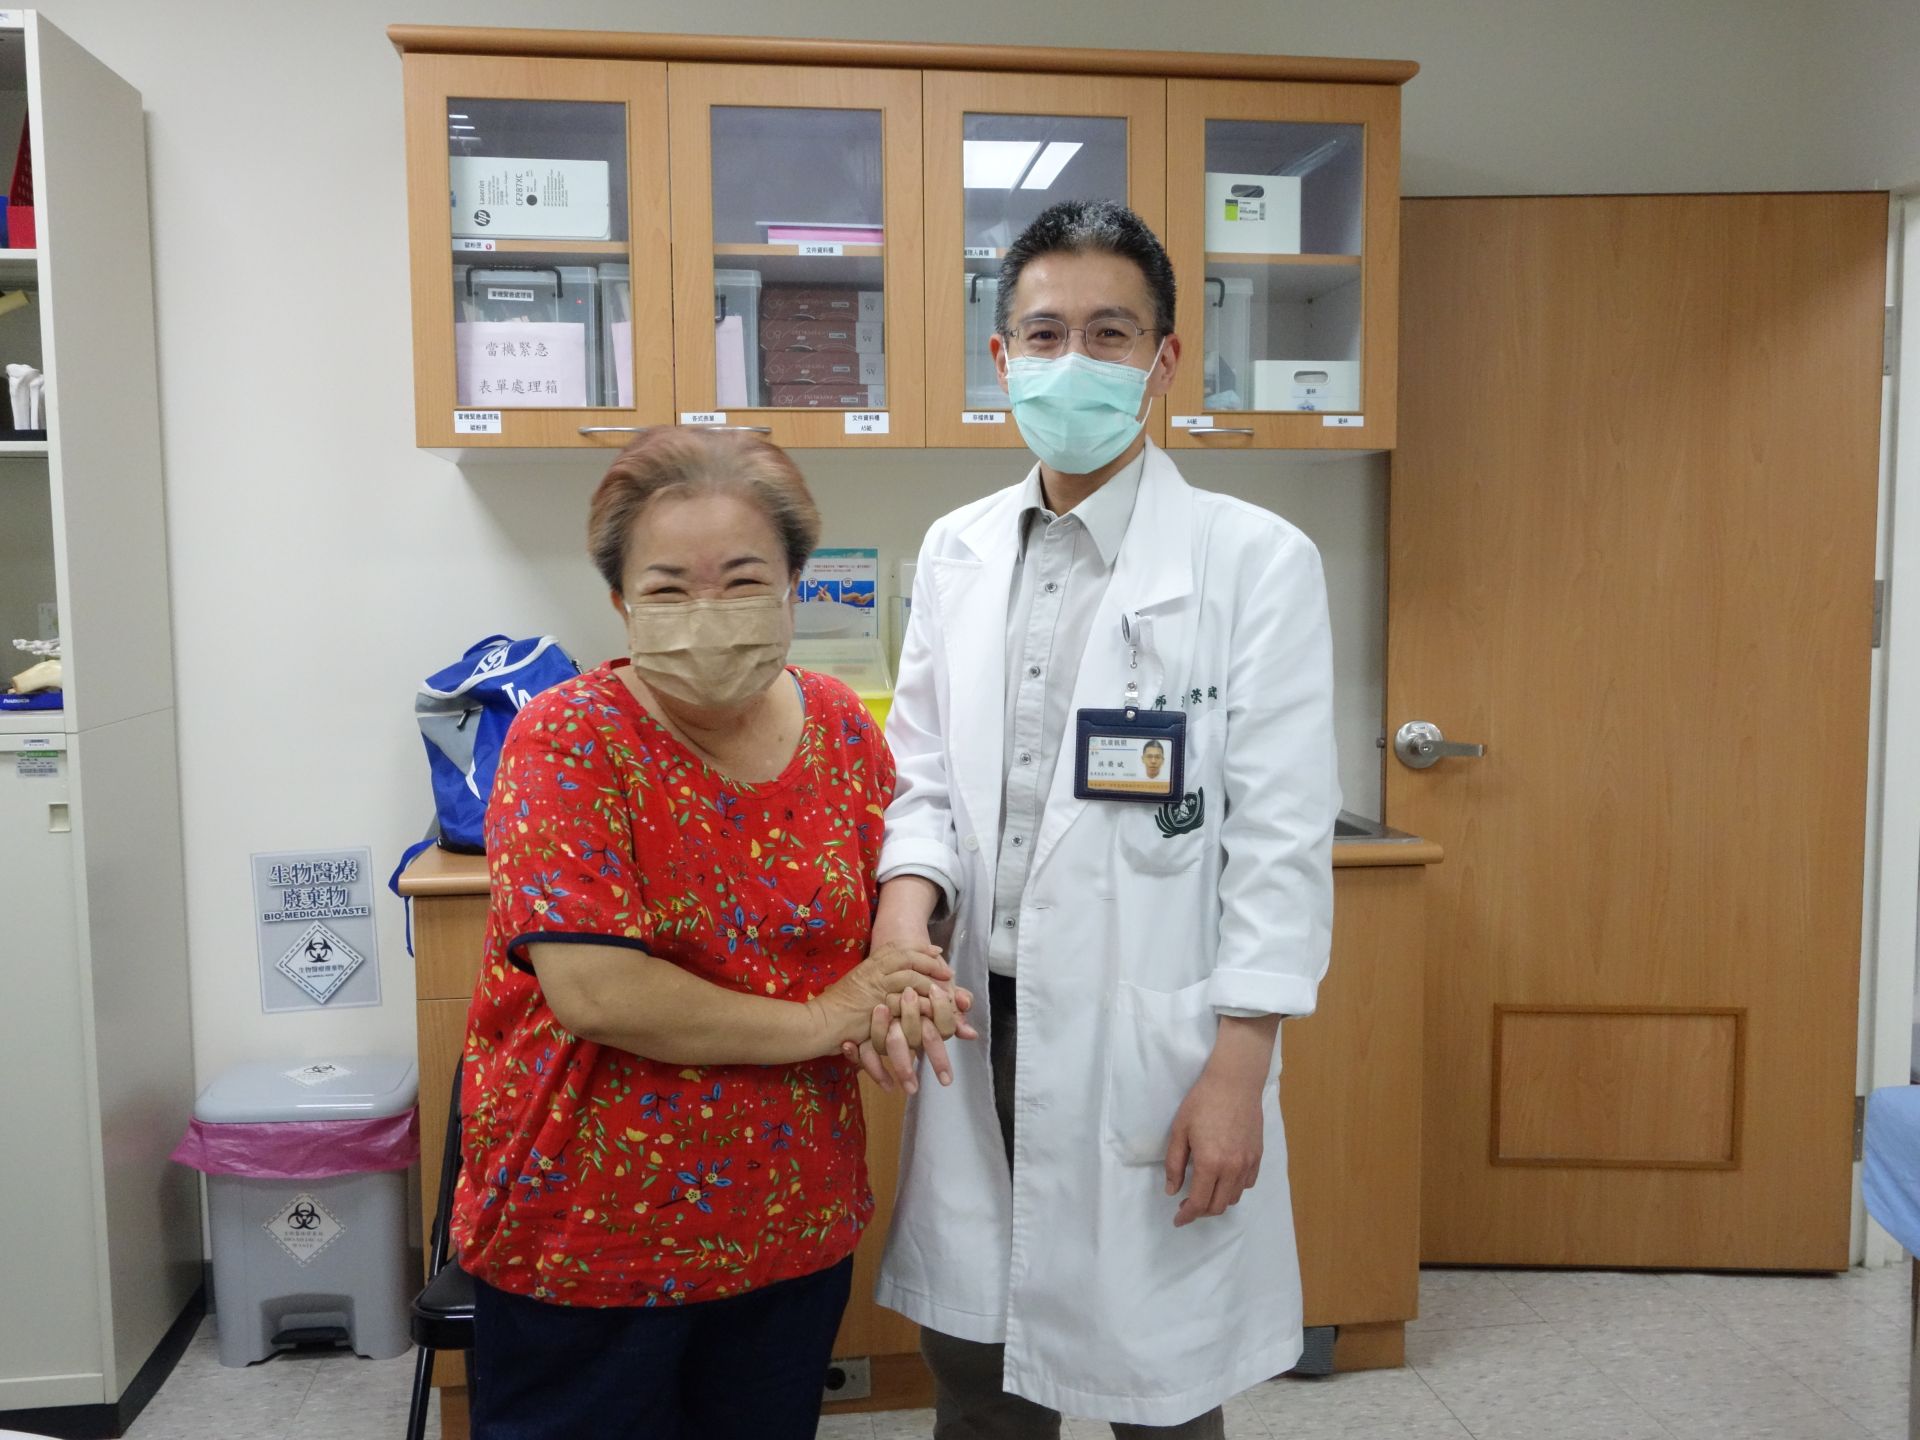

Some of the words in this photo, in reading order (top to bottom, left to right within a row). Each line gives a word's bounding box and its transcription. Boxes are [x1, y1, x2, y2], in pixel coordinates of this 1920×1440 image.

[515, 173, 524, 206] CF287XC
[474, 209, 491, 227] hp
[806, 246, 834, 254] 文件資料櫃
[485, 341, 549, 357] 當機緊急
[479, 378, 558, 394] 表單處理箱
[270, 860, 357, 884] 生物醫療
[283, 886, 348, 908] 廢棄物
[264, 910, 330, 921] BIO-MEDICAL
[332, 907, 368, 916] WASTE
